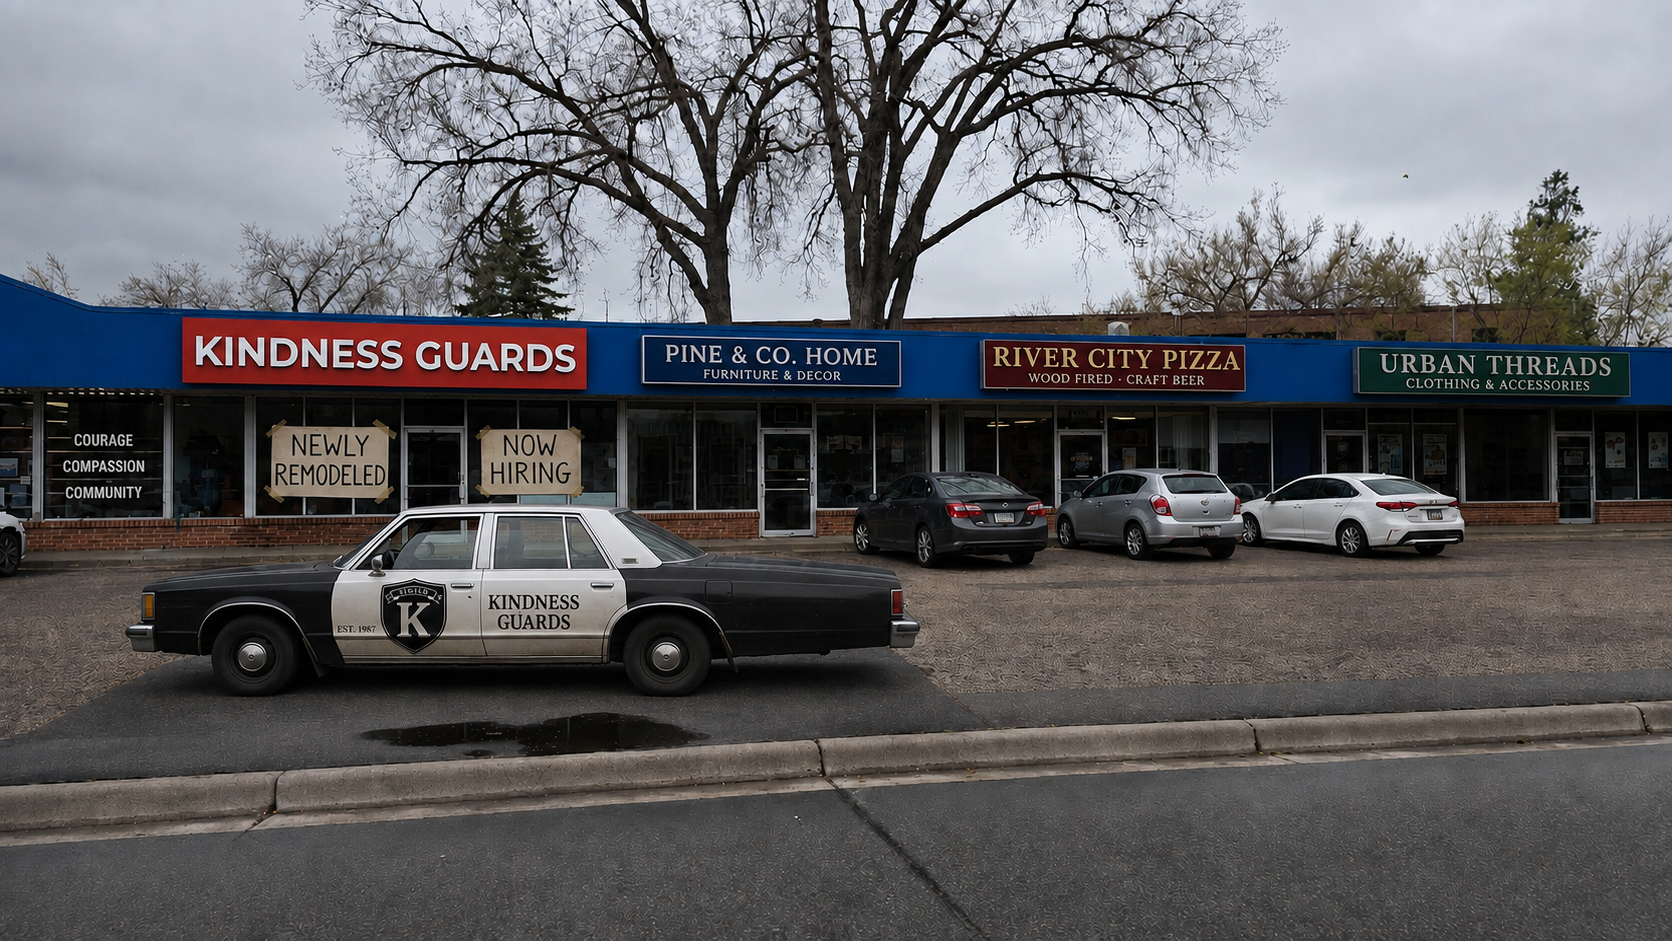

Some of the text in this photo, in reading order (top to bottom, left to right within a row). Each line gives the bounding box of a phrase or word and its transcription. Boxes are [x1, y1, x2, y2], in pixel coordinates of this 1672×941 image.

[195, 335, 577, 373] KINDNESS GUARDS
[665, 344, 878, 366] PINE & CO. HOME
[993, 346, 1241, 371] RIVER CITY PIZZA
[703, 368, 842, 381] FURNITURE & DECOR
[1380, 353, 1612, 377] URBAN THREADS
[1029, 373, 1071, 384] WOOD
[1075, 373, 1113, 385] FIRED
[1126, 374, 1169, 386] CRAFT
[1172, 375, 1205, 386] BEER
[1405, 377, 1590, 392] CLOTHING & ACCESSORIES
[74, 433, 134, 447] COURAGE
[291, 433, 370, 457] NEWLY
[503, 433, 558, 457] NOW
[62, 459, 145, 473] COMPASSION
[274, 462, 386, 487] REMODELED
[490, 462, 572, 485] HIRING
[66, 485, 142, 499] COMMUNITY
[488, 594, 580, 610] KINDNESS
[396, 601, 431, 637] K
[497, 613, 571, 630] GUARDS
[336, 624, 377, 634] EST. 1987
